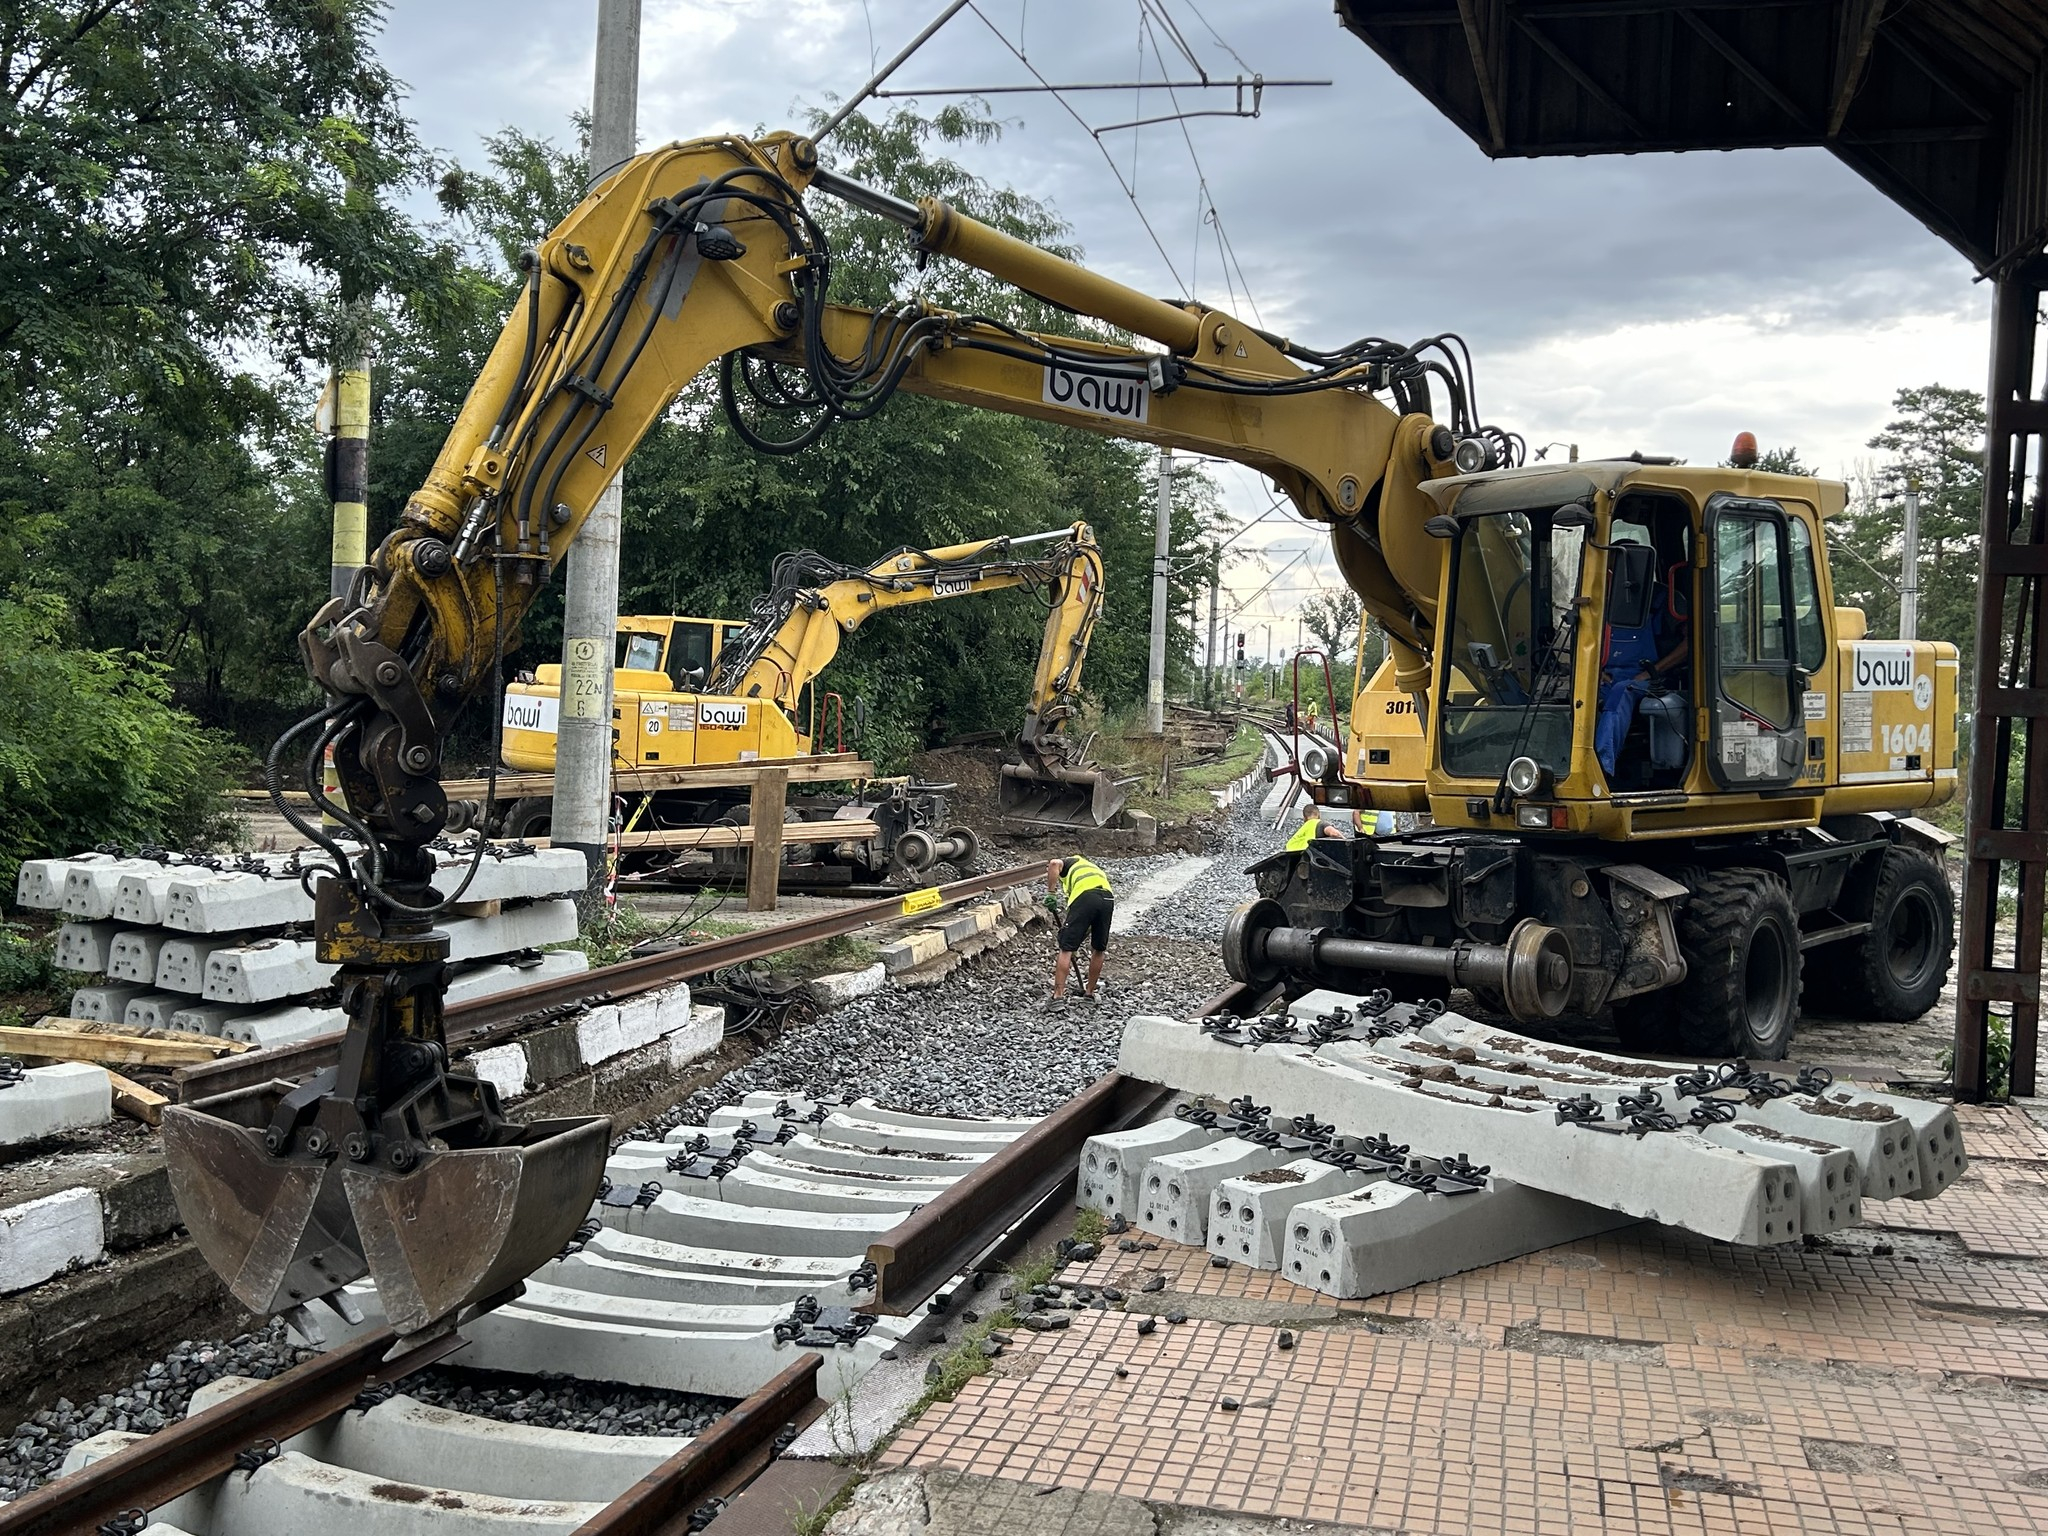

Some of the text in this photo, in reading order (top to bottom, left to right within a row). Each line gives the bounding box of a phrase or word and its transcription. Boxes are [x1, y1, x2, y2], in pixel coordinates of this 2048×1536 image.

[1050, 354, 1144, 418] bawi
[934, 576, 969, 595] bawi
[1857, 648, 1911, 686] bawi
[507, 697, 541, 728] bawi
[648, 720, 660, 732] 20
[701, 703, 746, 724] bawi
[1881, 724, 1931, 754] 1604
